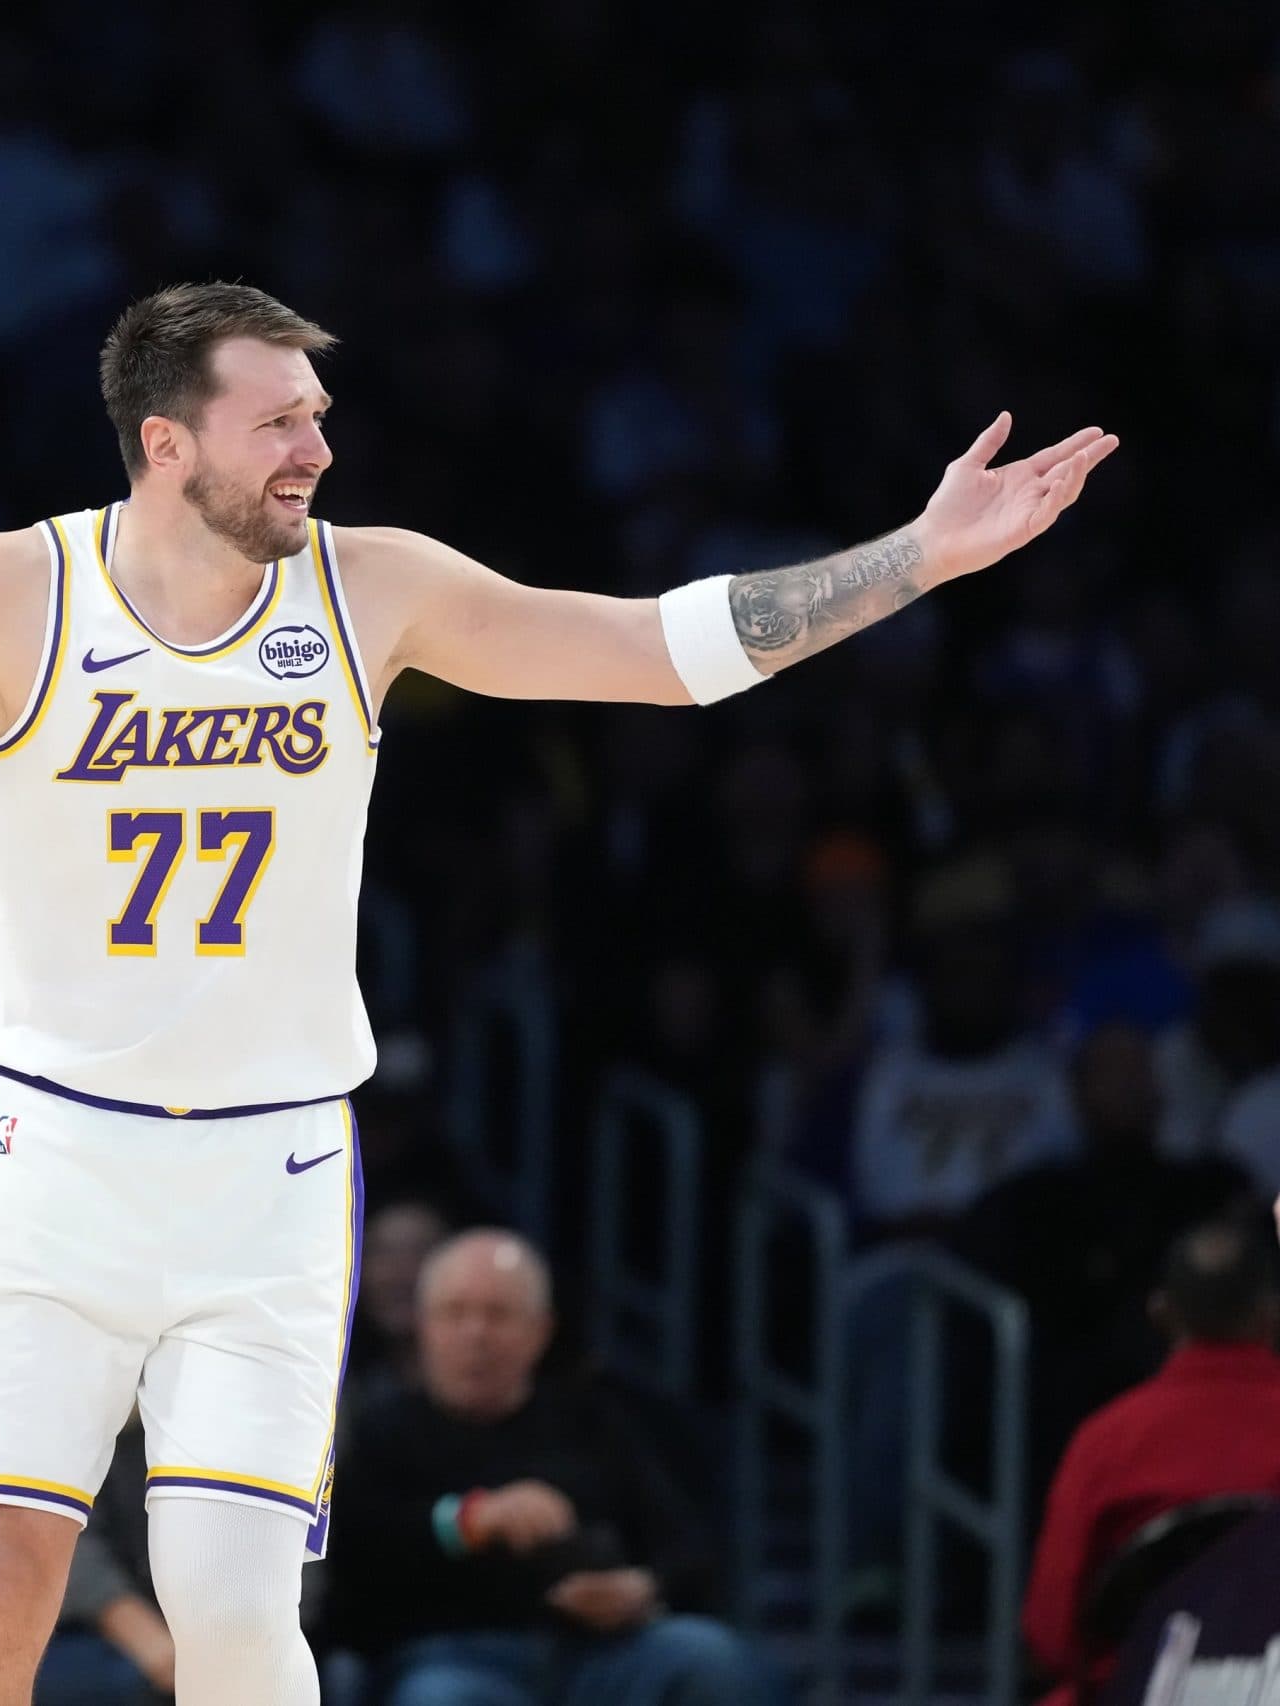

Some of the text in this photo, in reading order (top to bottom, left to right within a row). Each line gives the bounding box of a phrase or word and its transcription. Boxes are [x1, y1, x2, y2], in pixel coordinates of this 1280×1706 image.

[264, 639, 325, 662] bibigo
[53, 689, 332, 784] LAKERS
[106, 806, 276, 957] 77
